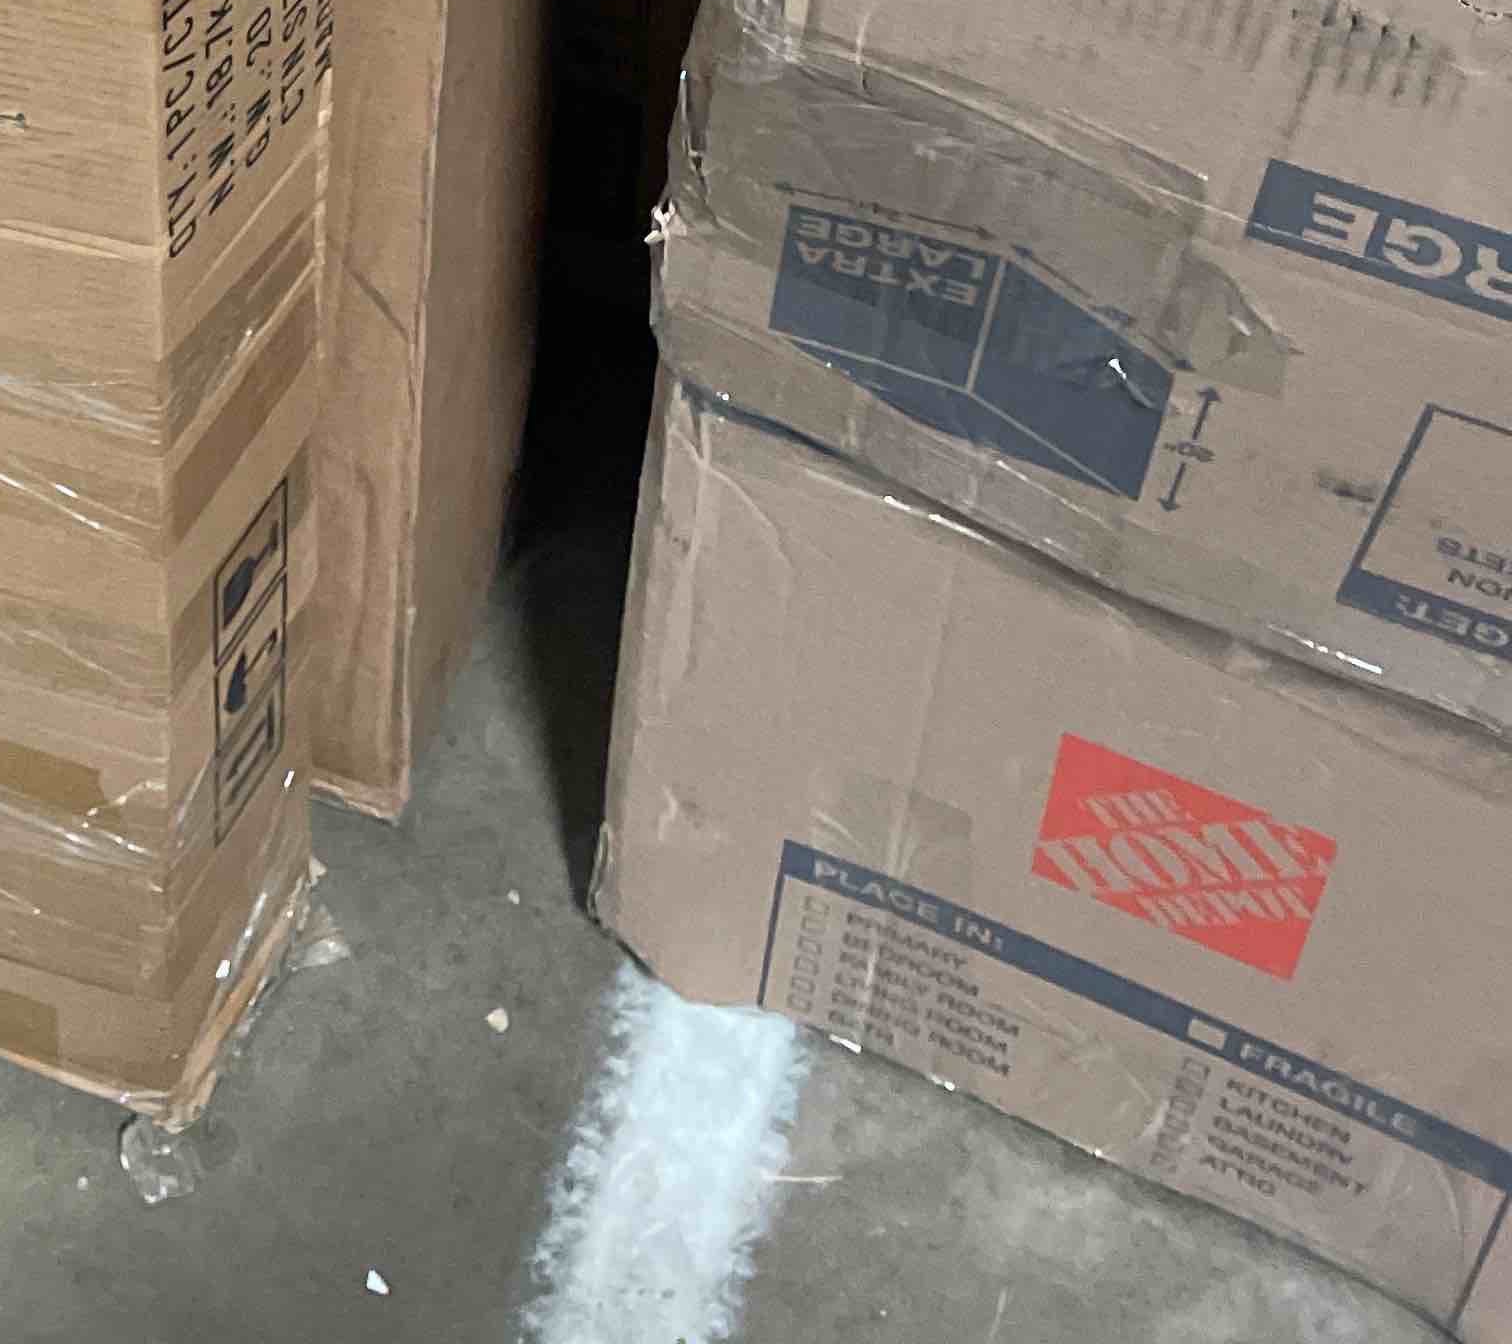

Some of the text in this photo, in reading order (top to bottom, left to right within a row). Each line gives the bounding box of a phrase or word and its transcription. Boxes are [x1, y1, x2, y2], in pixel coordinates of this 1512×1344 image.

[281, 37, 304, 128] CTN
[796, 215, 985, 280] LARGE
[796, 240, 978, 306] EXTRA
[1080, 789, 1184, 828] THE
[1035, 820, 1328, 892] HOME
[815, 861, 1004, 951] PLACE IN:
[1136, 886, 1314, 928] DEPOT
[1240, 1043, 1417, 1136] FRAGILE
